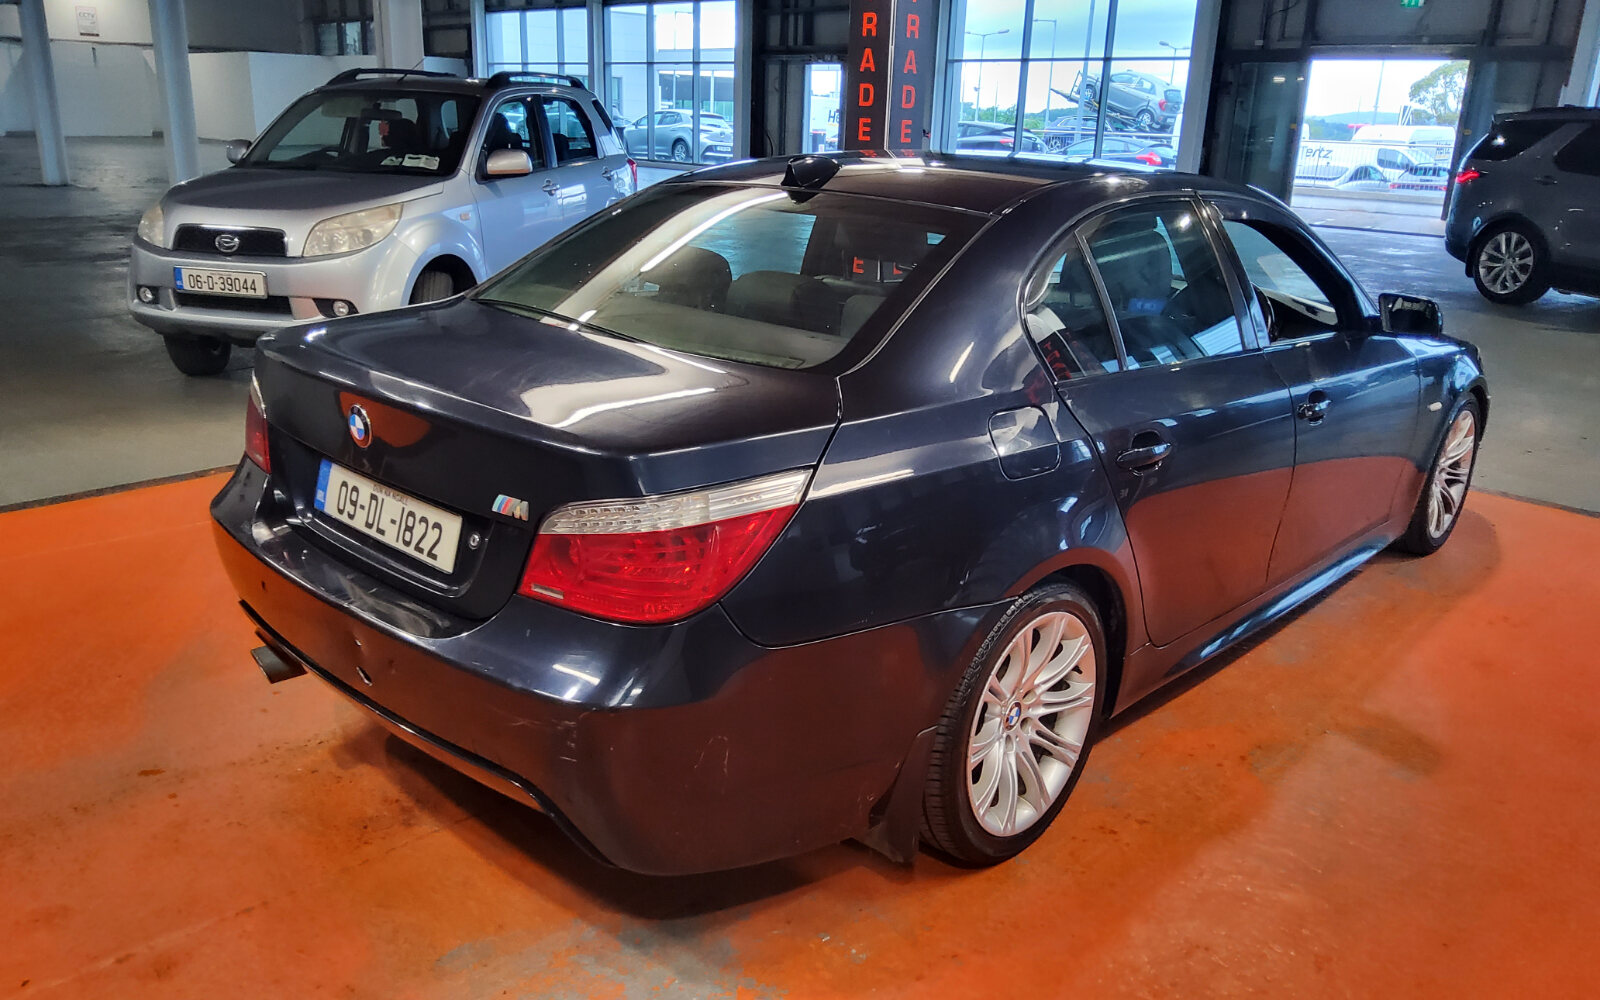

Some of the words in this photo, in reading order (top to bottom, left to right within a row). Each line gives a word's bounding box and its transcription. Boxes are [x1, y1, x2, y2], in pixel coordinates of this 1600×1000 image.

[858, 0, 877, 141] RADE
[901, 0, 920, 143] RADE
[188, 274, 257, 293] 06-D-39044
[337, 480, 443, 561] 09-DL-1822
